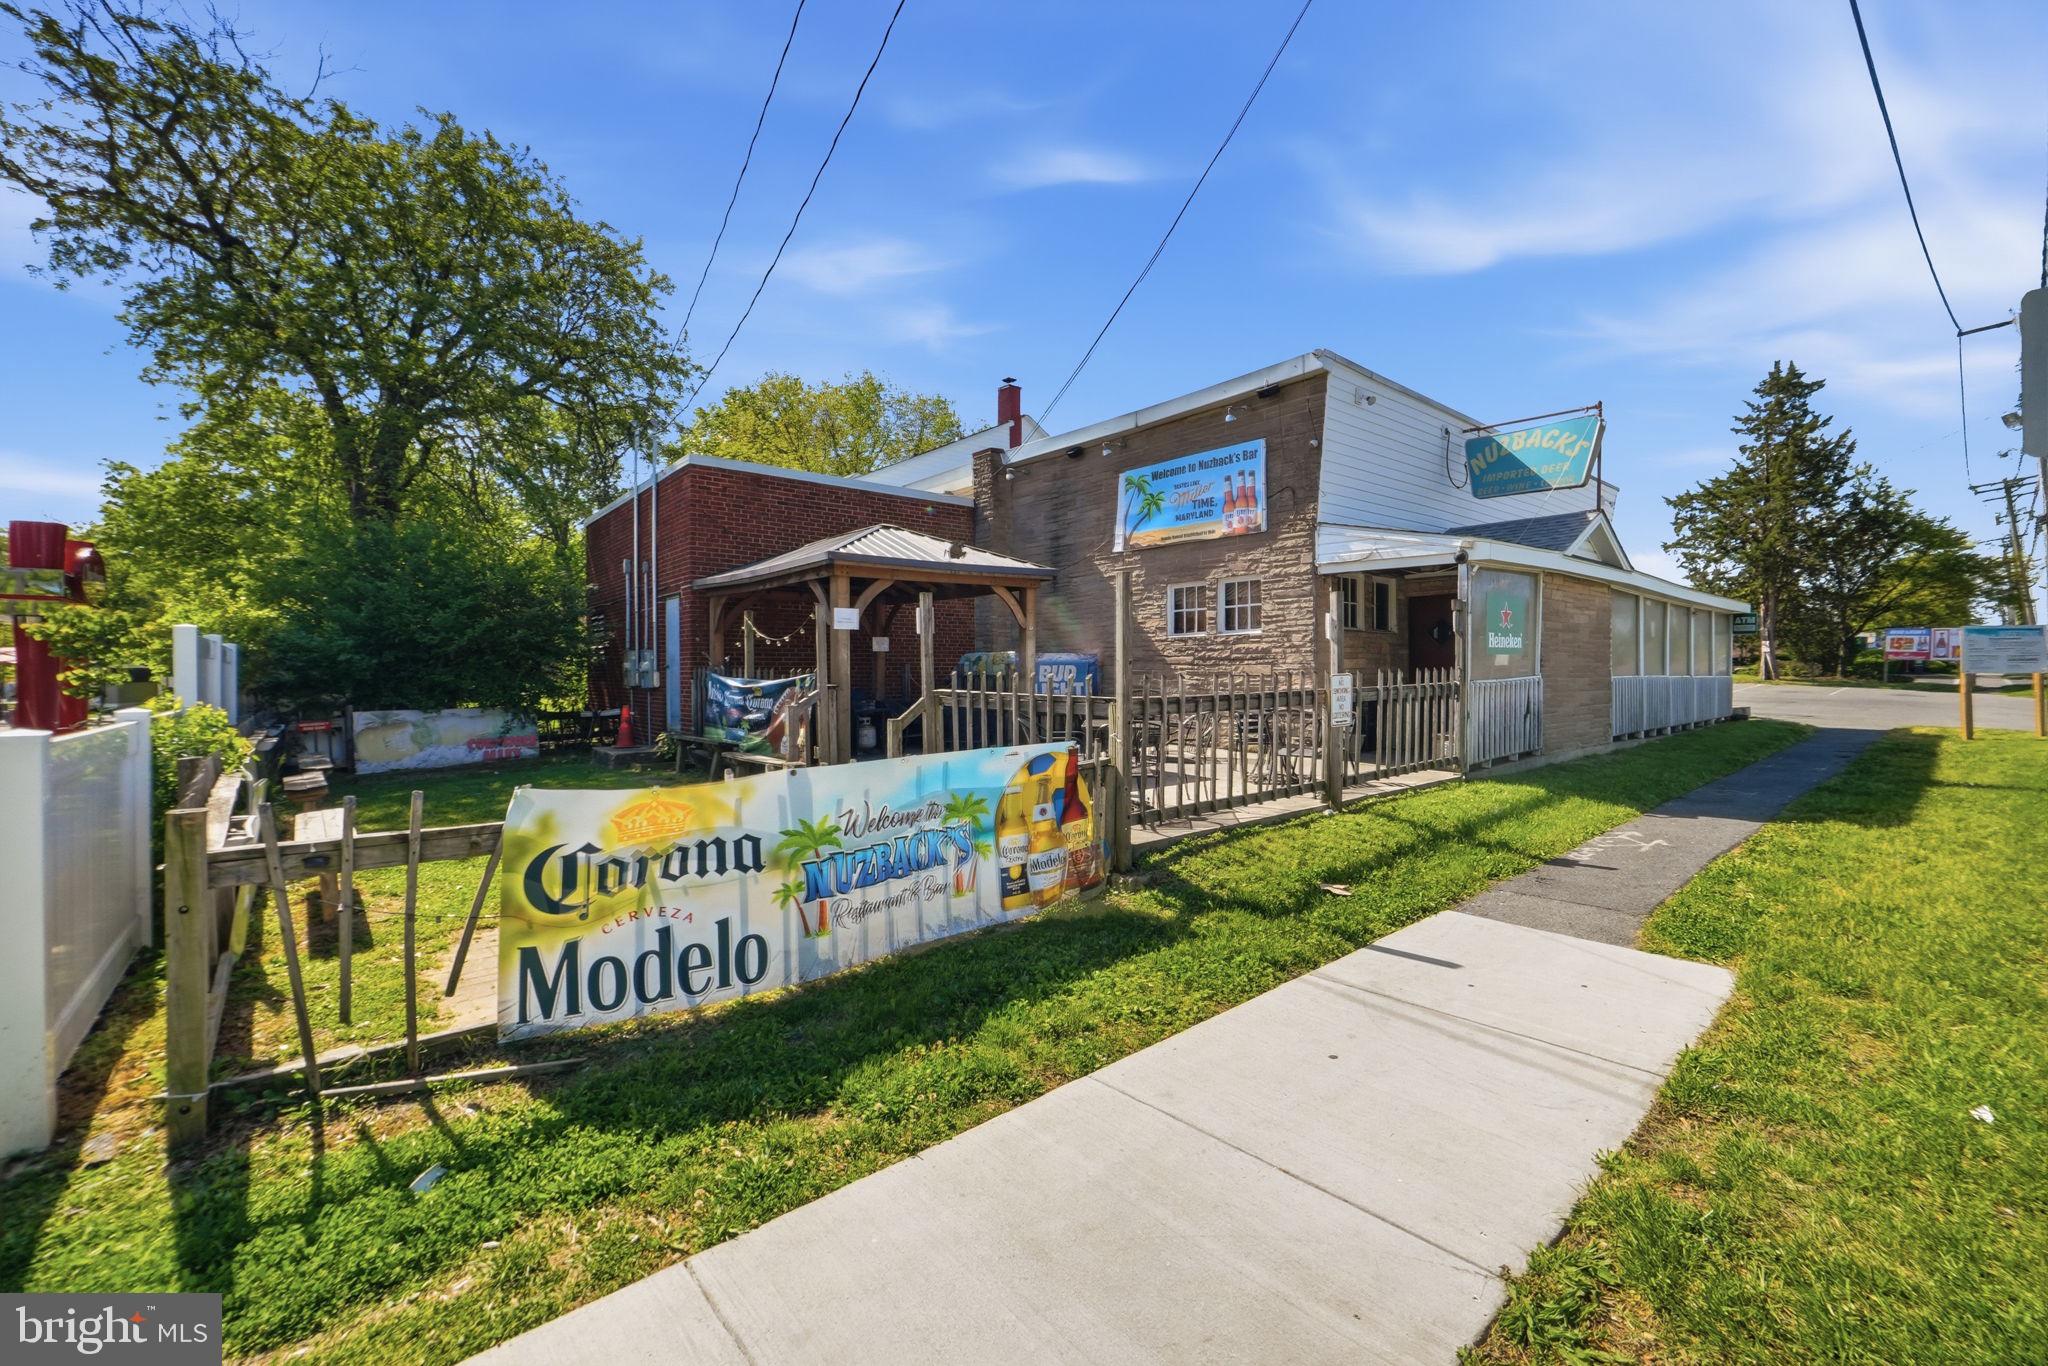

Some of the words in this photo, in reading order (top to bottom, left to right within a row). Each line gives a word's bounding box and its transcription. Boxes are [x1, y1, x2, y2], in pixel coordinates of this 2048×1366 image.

[1151, 466, 1187, 481] Welcome
[1188, 463, 1196, 473] to
[1198, 453, 1241, 471] Nuzback's
[1242, 449, 1258, 461] Bar
[1482, 467, 1538, 482] IMPORTED
[1175, 509, 1214, 522] MARYLAND
[1192, 496, 1218, 509] TIME,
[1488, 632, 1523, 649] Heineken
[1039, 664, 1077, 682] BUD
[838, 800, 925, 839] Welcome
[926, 800, 944, 820] to
[523, 833, 767, 921] Corona
[801, 821, 974, 904] NUZBACK'S
[1030, 853, 1067, 872] Modelo
[830, 888, 909, 929] Restaurant
[921, 874, 951, 901] Bar
[601, 906, 694, 935] CERVEZA
[516, 915, 771, 1025] Modelo
